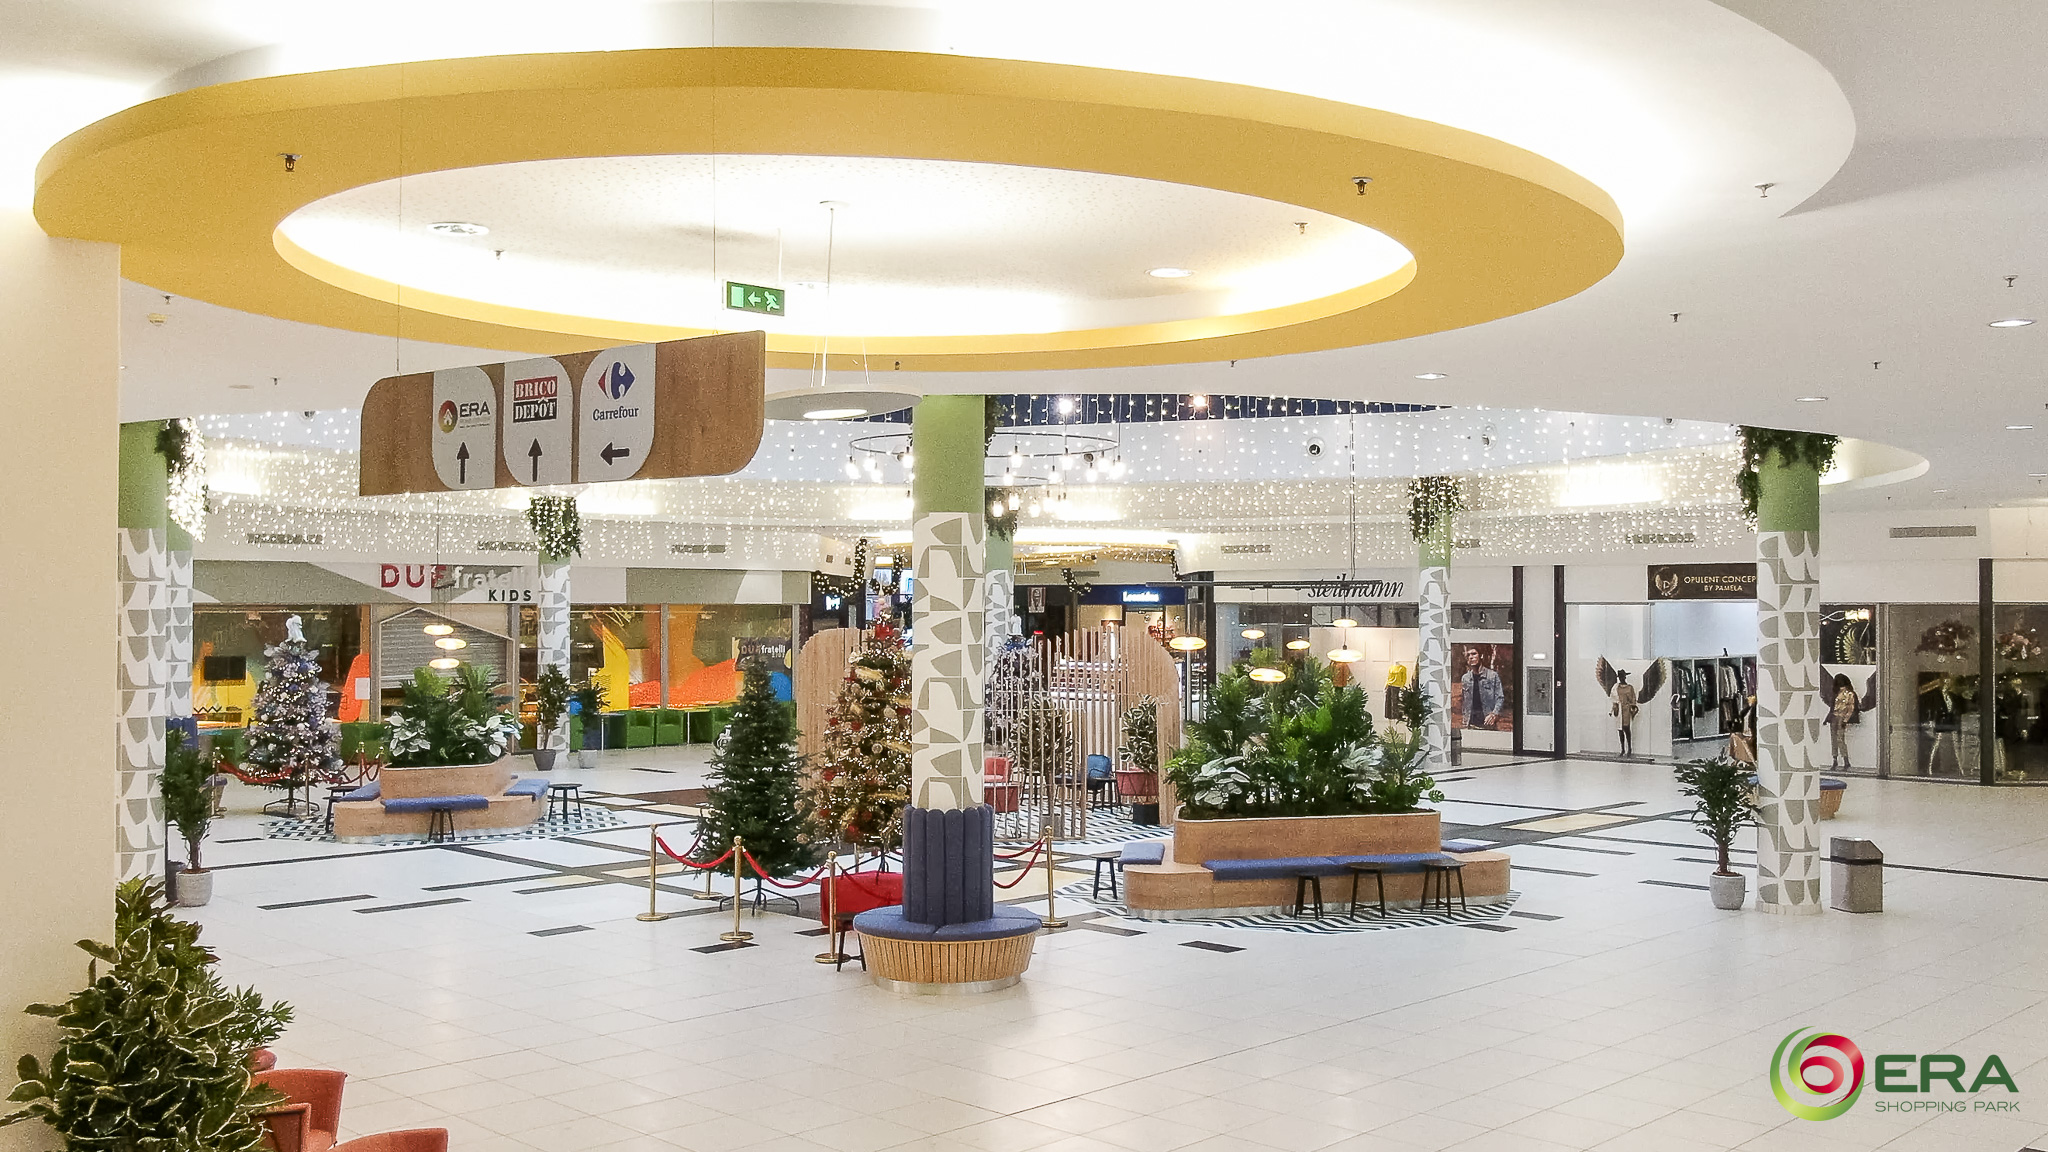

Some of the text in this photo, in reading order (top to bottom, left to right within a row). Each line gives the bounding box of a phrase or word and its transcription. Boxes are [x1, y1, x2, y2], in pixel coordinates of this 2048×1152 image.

[515, 379, 556, 399] BRICO
[459, 401, 491, 418] ERA
[514, 397, 556, 420] DEPÔT
[592, 405, 640, 421] Carrefour
[1683, 576, 1720, 584] OPULENT
[1703, 584, 1743, 592] BY PAMELA
[488, 589, 532, 602] KIDS
